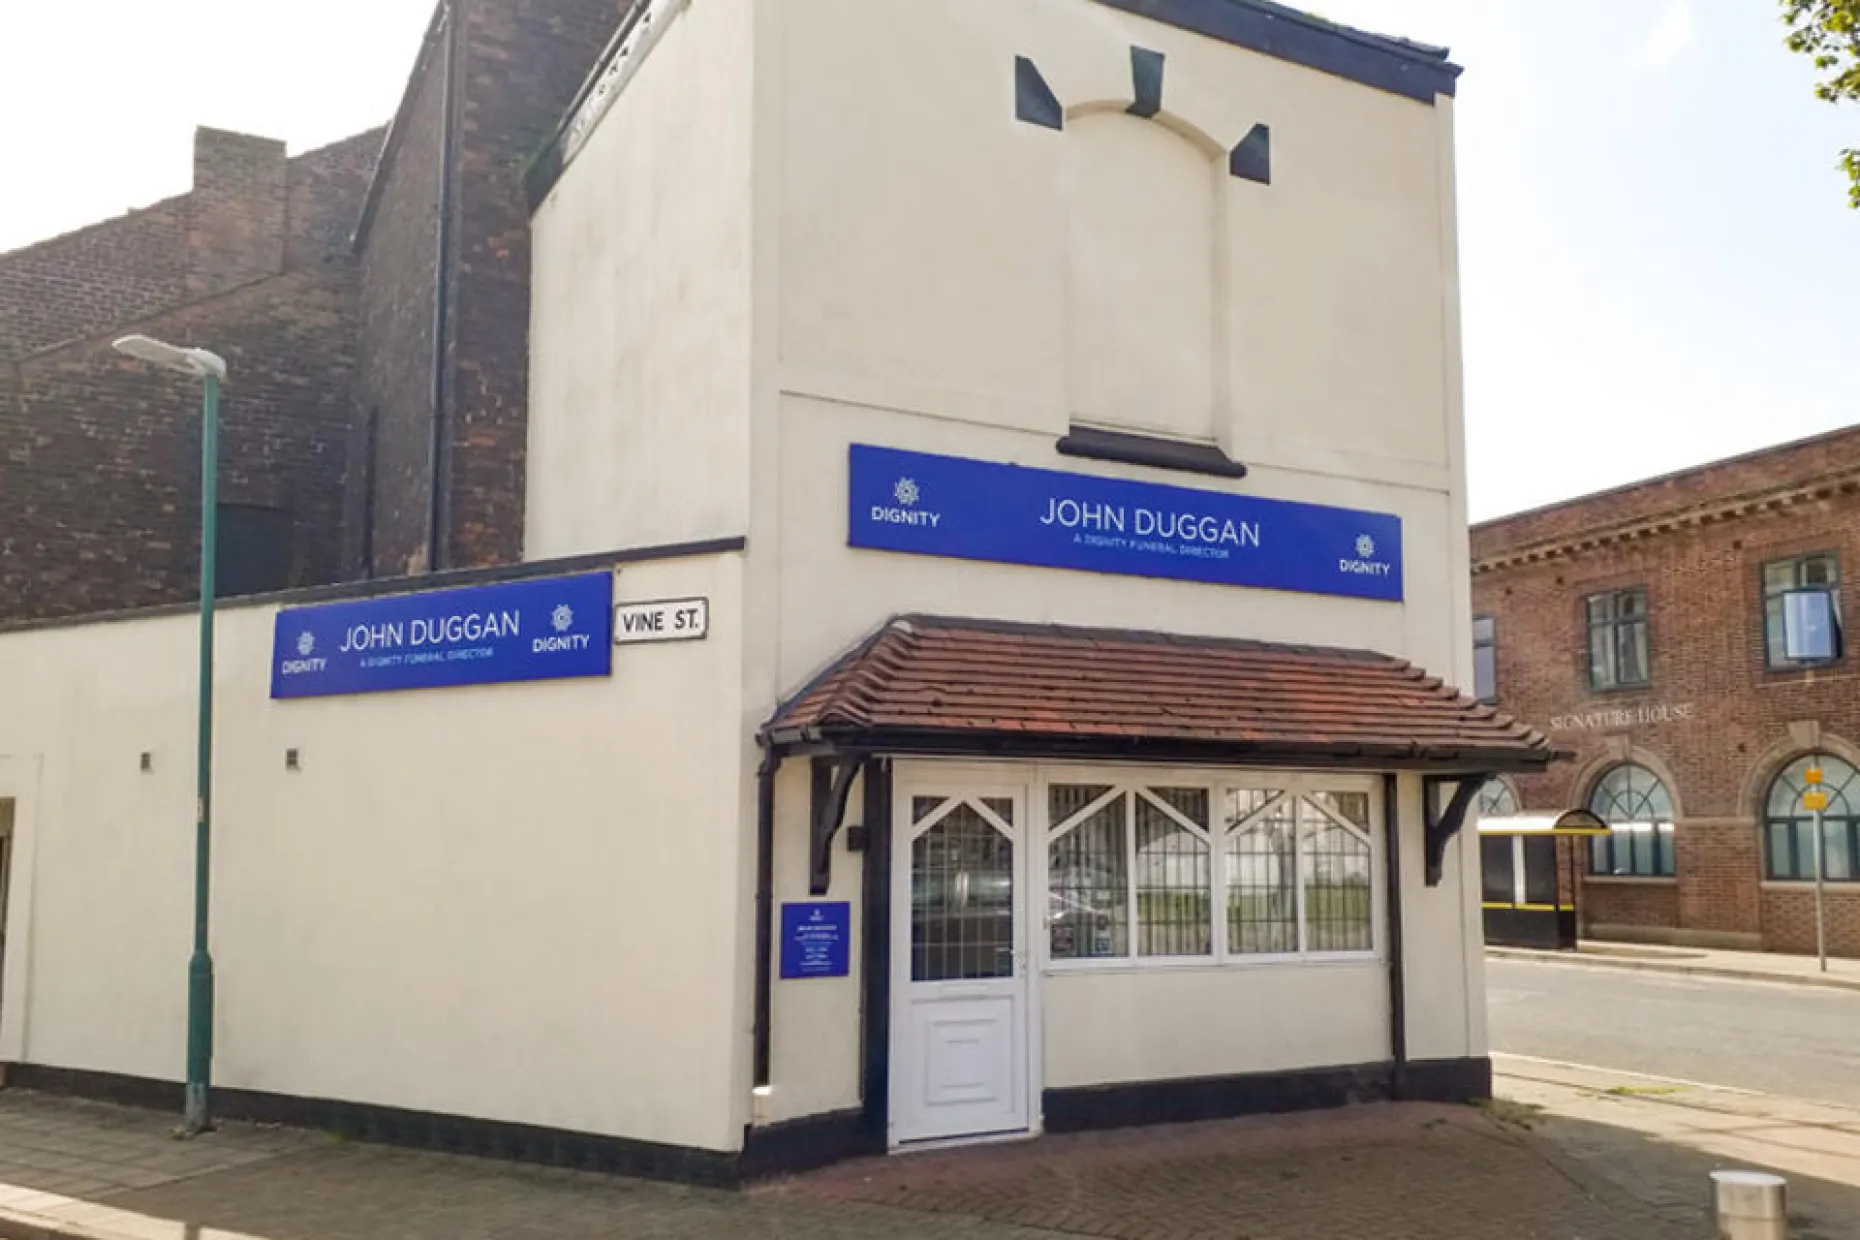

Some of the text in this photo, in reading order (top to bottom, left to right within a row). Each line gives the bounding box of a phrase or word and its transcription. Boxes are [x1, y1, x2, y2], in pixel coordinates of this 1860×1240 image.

[871, 506, 941, 527] DIGNITY
[1040, 497, 1260, 547] JOHN DUGGAN
[1073, 534, 1230, 560] A DIGNITY FUNERAL DIRECTOR
[1340, 559, 1390, 577] DIGNITY
[340, 609, 521, 653] JOHN DUGGAN
[623, 609, 699, 633] VINE ST.
[532, 633, 590, 653] DIGNITY
[282, 658, 326, 675] DIGNITY
[367, 654, 402, 667] DIGNITY
[404, 650, 445, 665] FUNERAL
[447, 647, 493, 662] DIRECTOR
[1550, 702, 1694, 729] SIGNATURE HOUSE
